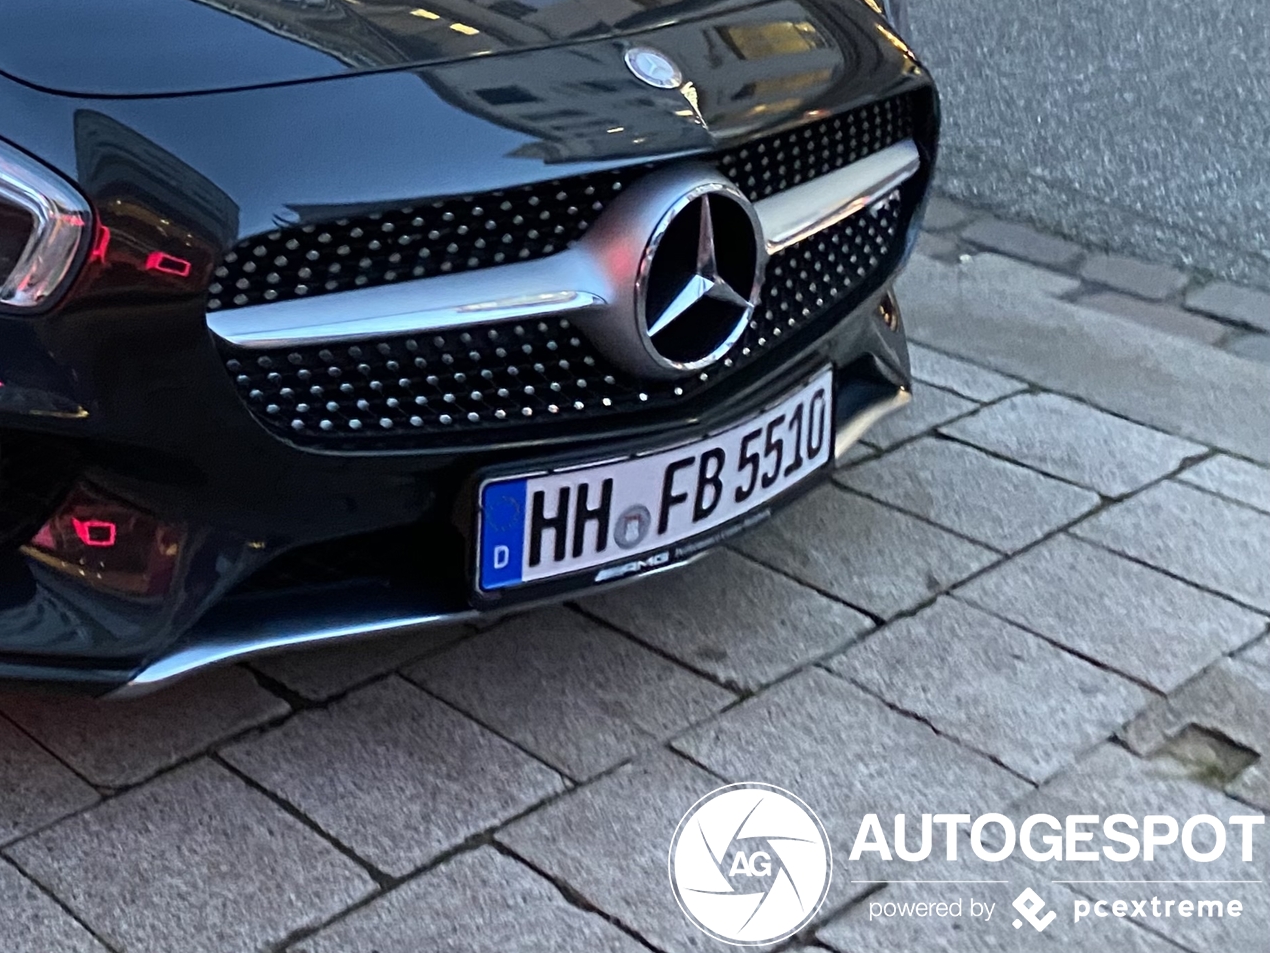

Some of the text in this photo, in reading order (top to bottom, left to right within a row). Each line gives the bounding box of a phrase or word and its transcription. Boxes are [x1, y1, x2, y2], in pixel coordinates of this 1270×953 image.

[528, 478, 614, 568] HH
[658, 446, 726, 535] FB
[734, 388, 826, 505] 5510
[493, 545, 510, 569] D
